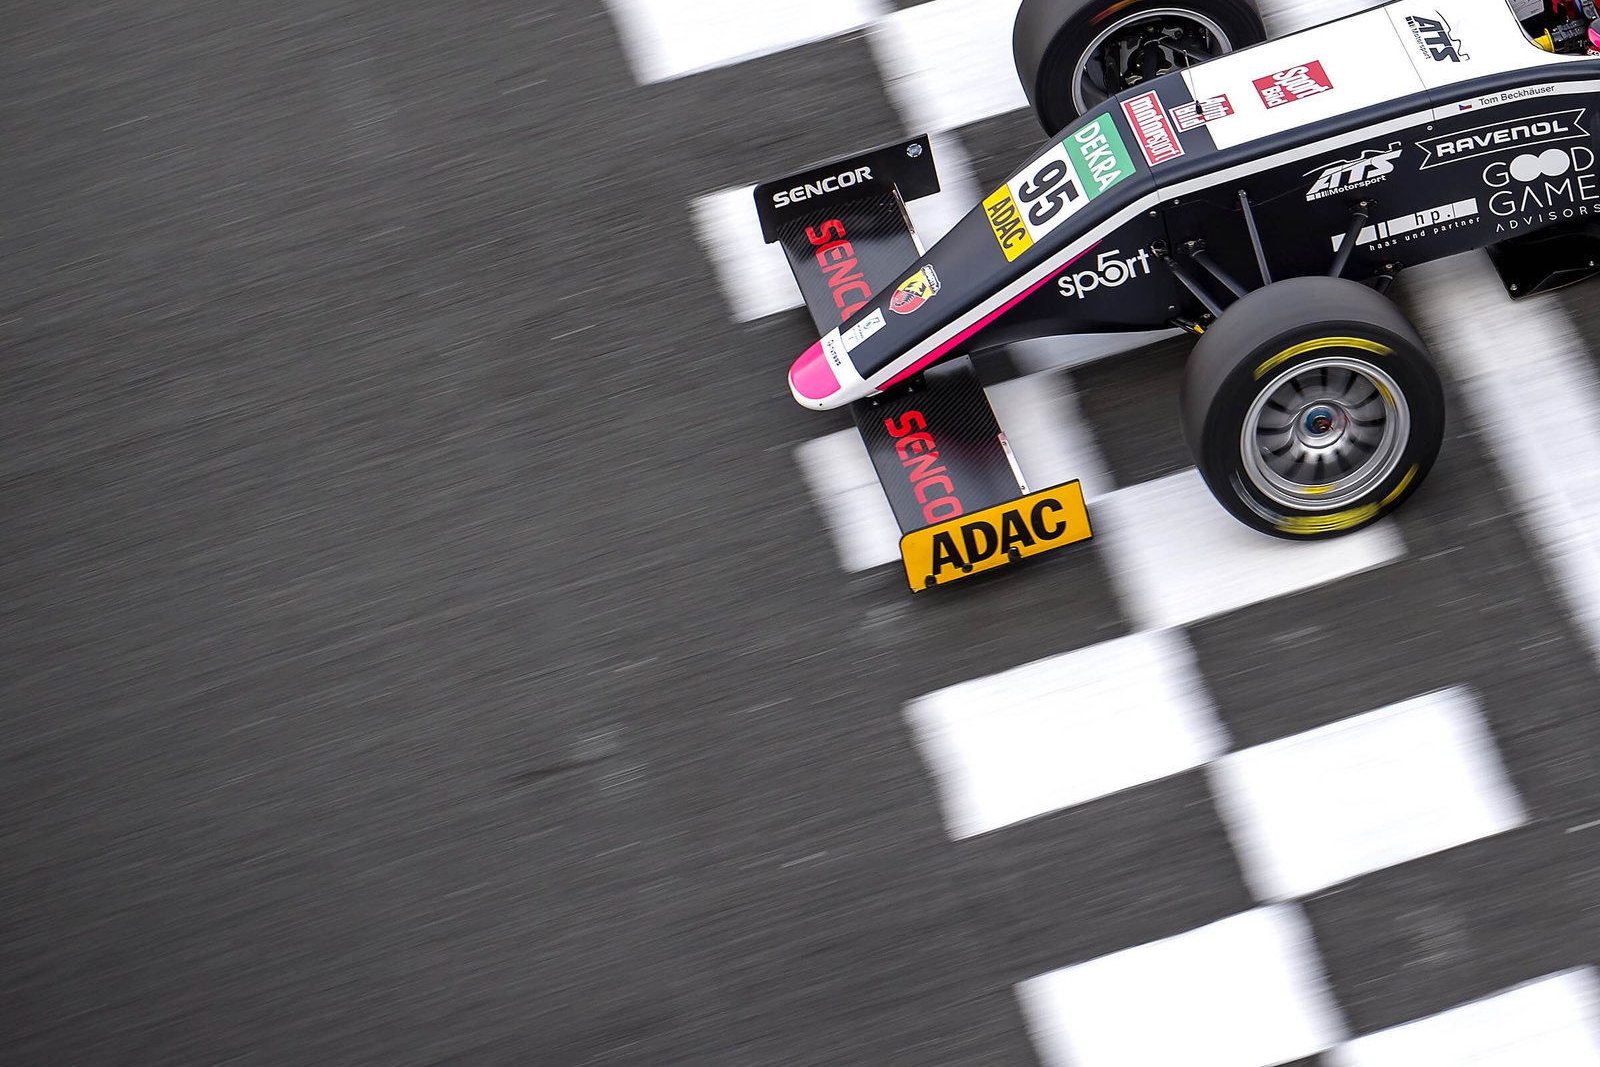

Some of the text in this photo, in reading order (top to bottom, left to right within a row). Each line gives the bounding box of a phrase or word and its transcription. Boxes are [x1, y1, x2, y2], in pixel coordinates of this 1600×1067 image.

[1412, 15, 1461, 63] ATS
[1260, 85, 1289, 108] Bild
[1271, 65, 1330, 99] Sport
[1478, 85, 1556, 107] Tom Beckhäuser
[1129, 95, 1181, 162] motorsport
[1436, 120, 1569, 158] RAVENOL
[1074, 121, 1122, 192] DEKRA
[1306, 149, 1403, 196] ATS
[1482, 146, 1595, 188] GOOD
[772, 165, 874, 209] SENCOR
[1018, 159, 1080, 227] 95
[1329, 174, 1387, 196] Motorsport
[1488, 174, 1600, 217] GAME
[987, 196, 1026, 250] ADAC
[1369, 216, 1481, 252] haas und partner
[884, 410, 964, 524] SENCO
[932, 498, 1067, 576] ADAC
